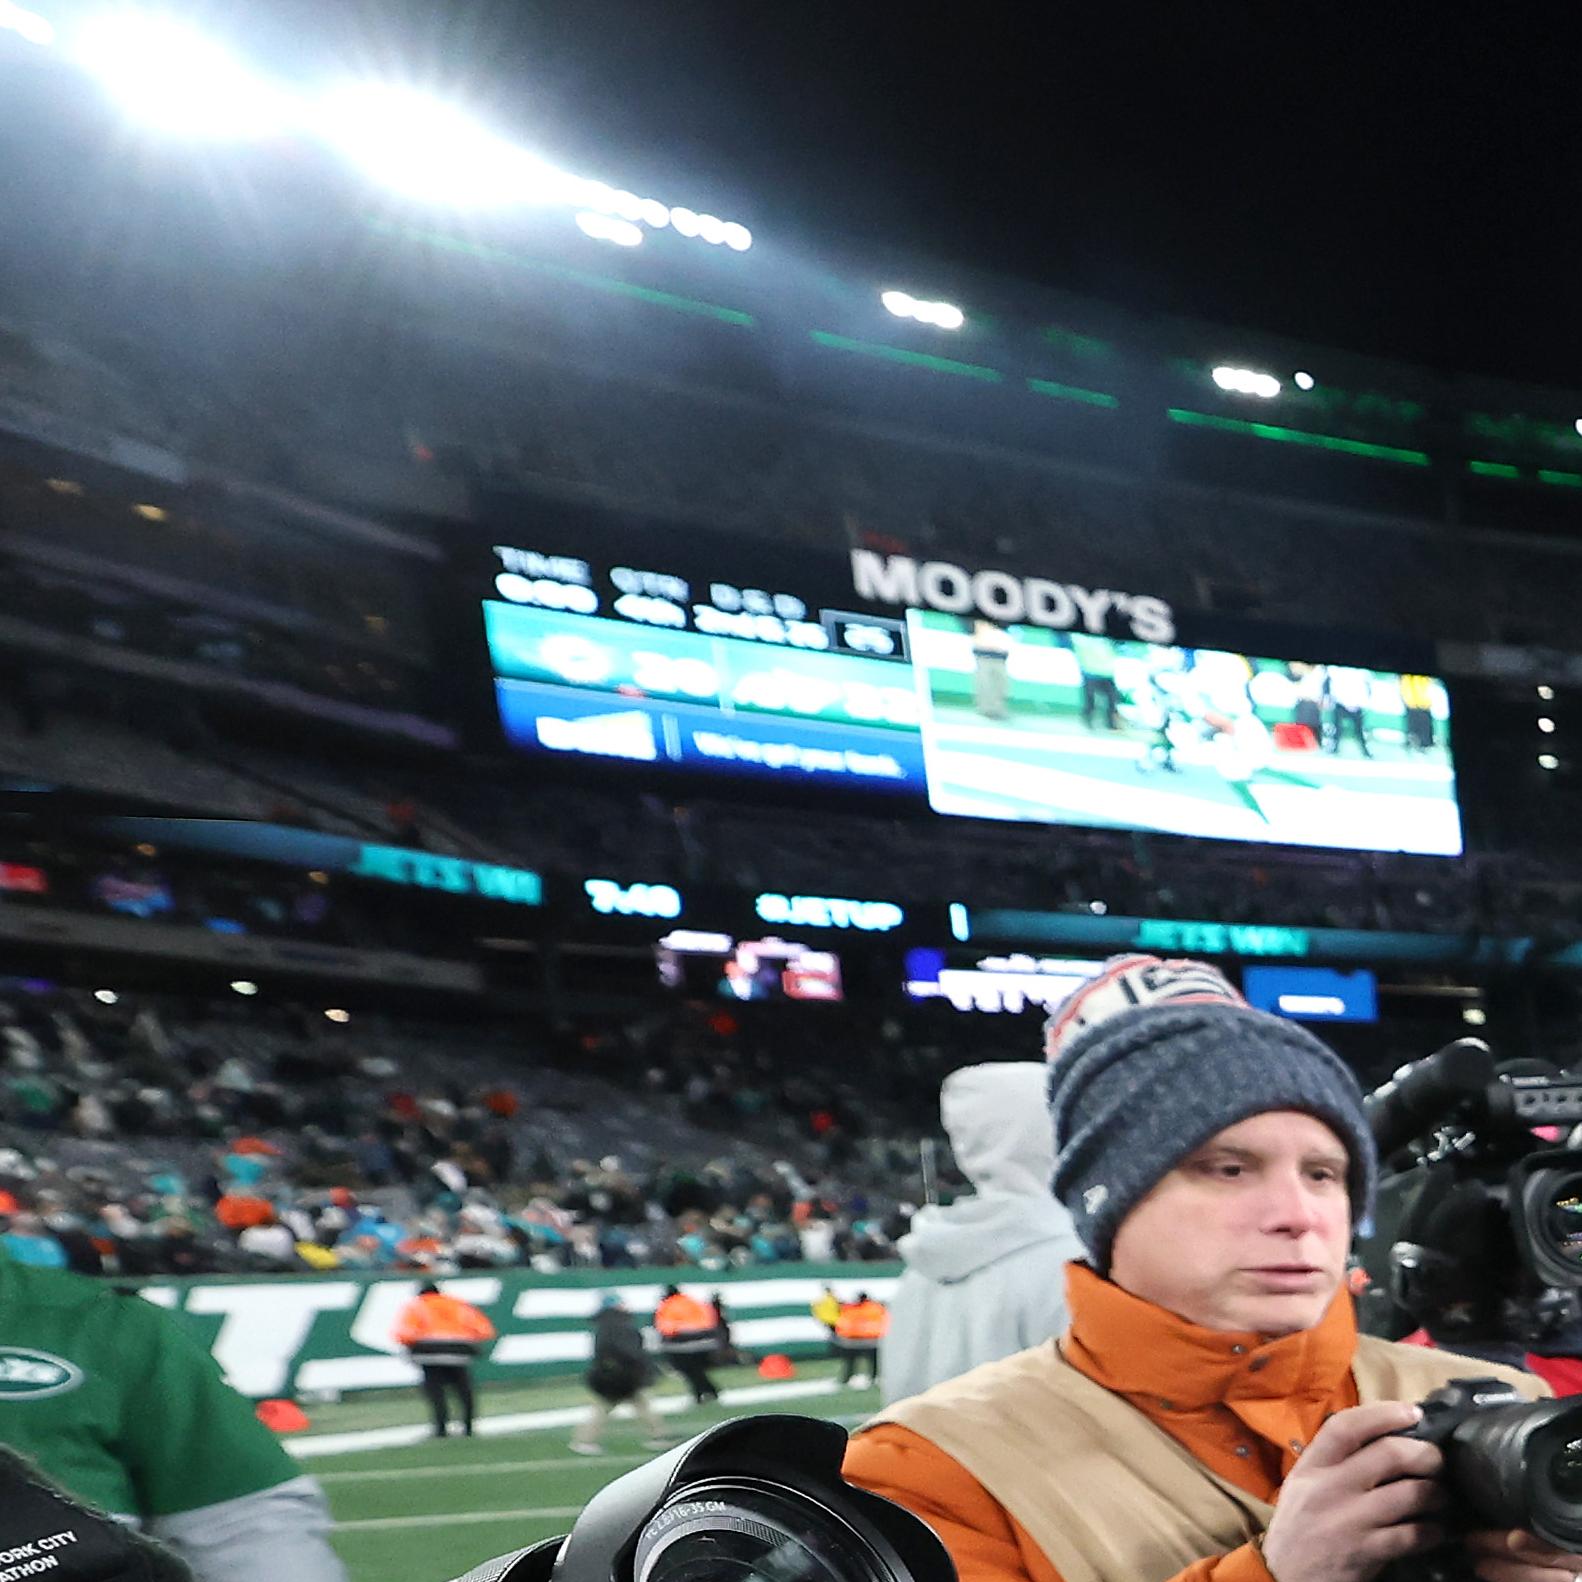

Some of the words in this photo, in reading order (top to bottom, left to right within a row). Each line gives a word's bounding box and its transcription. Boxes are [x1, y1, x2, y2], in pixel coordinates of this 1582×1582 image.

[851, 548, 1176, 645] MOODY'S
[139, 1276, 502, 1399] TS
[0, 1543, 41, 1566] ORK
[38, 1531, 77, 1550] CITY
